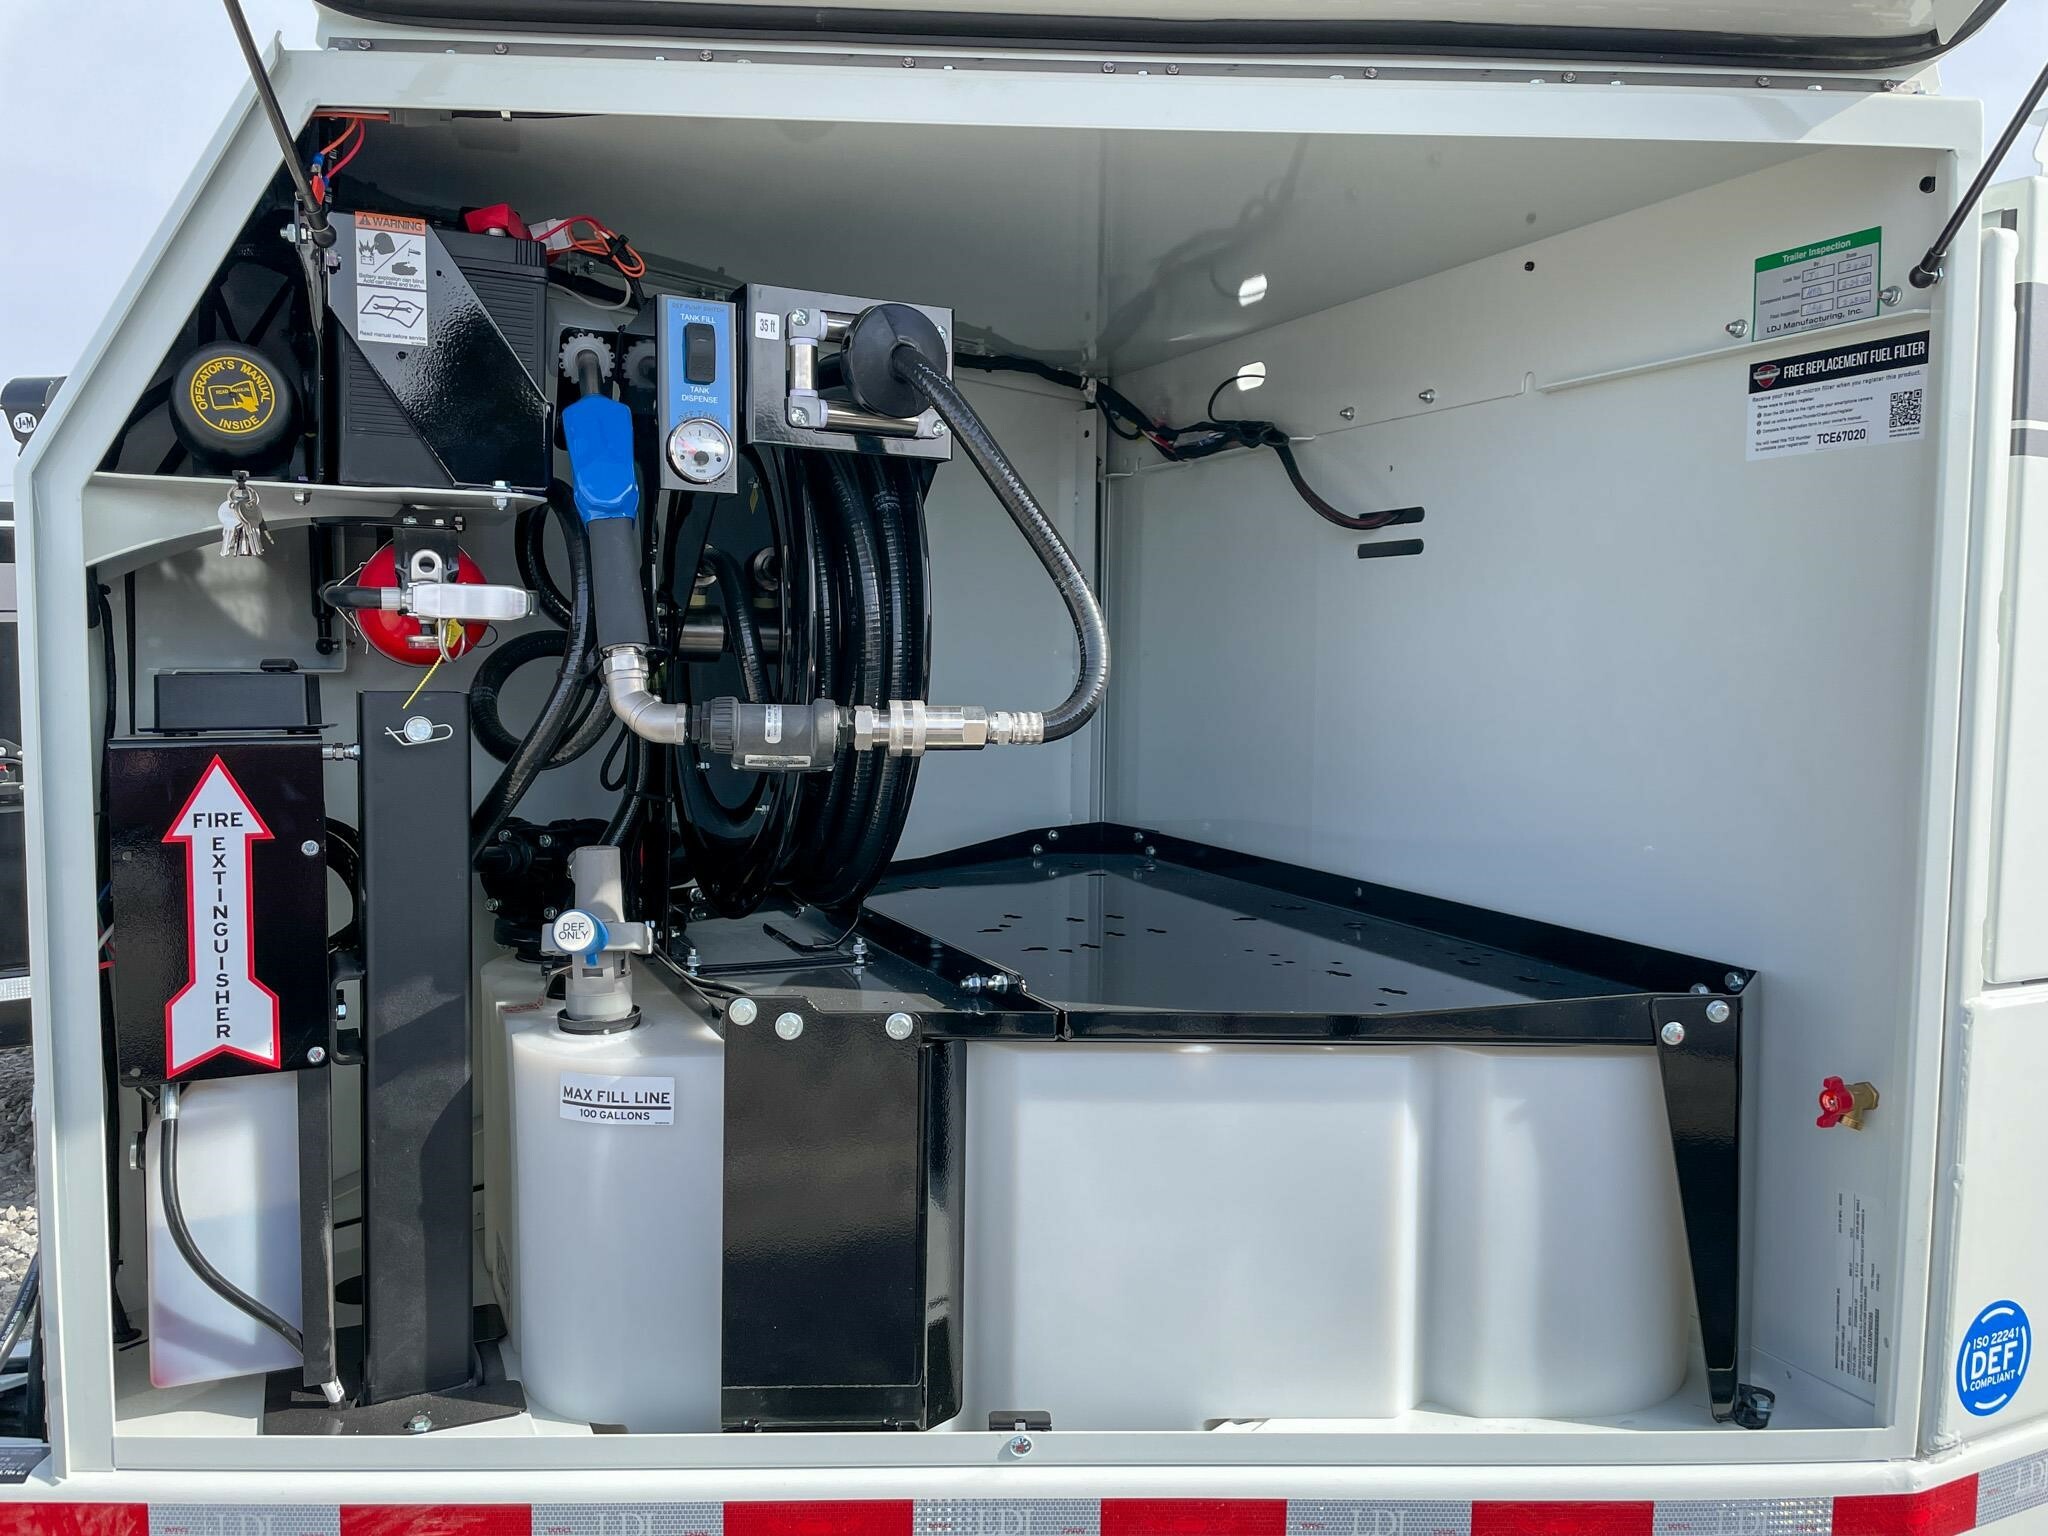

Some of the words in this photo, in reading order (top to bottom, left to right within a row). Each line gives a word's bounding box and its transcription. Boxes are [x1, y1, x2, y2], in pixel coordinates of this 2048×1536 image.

[373, 217, 422, 231] WARNING
[1782, 251, 1807, 263] Trailer
[1808, 240, 1851, 256] Inspection
[680, 313, 700, 321] TANK
[701, 315, 716, 323] FILL
[759, 319, 769, 332] 35
[770, 320, 776, 333] ft
[1766, 324, 1782, 334] LDJ
[1783, 312, 1845, 330] Manufacturing,
[1847, 308, 1864, 316] Inc.
[1783, 363, 1805, 379] FREE
[1806, 351, 1869, 375] REPLACEMENT
[1870, 347, 1893, 363] FUEL
[1894, 341, 1925, 359] FILTER
[194, 360, 235, 411] OPERATOR'S
[240, 363, 271, 403] MANUAL
[689, 386, 710, 394] TANK
[681, 394, 719, 404] DISPENSE
[218, 415, 260, 430] INSIDE
[1816, 428, 1866, 445] TCE67020
[193, 812, 243, 828] FIRE
[558, 930, 589, 940] ONLY
[562, 922, 585, 932] DEF
[212, 837, 231, 1039] EXTINGUISHER
[563, 1085, 593, 1102] MAX
[597, 1090, 630, 1104] FILL
[634, 1091, 670, 1104] LINE
[579, 1108, 597, 1118] 100
[599, 1110, 650, 1121] GALLONS
[1973, 1335, 1990, 1350] ISO
[1990, 1326, 2019, 1345] 22241
[1970, 1340, 2018, 1381] DEF
[1969, 1369, 2016, 1392] COMPLIANT
